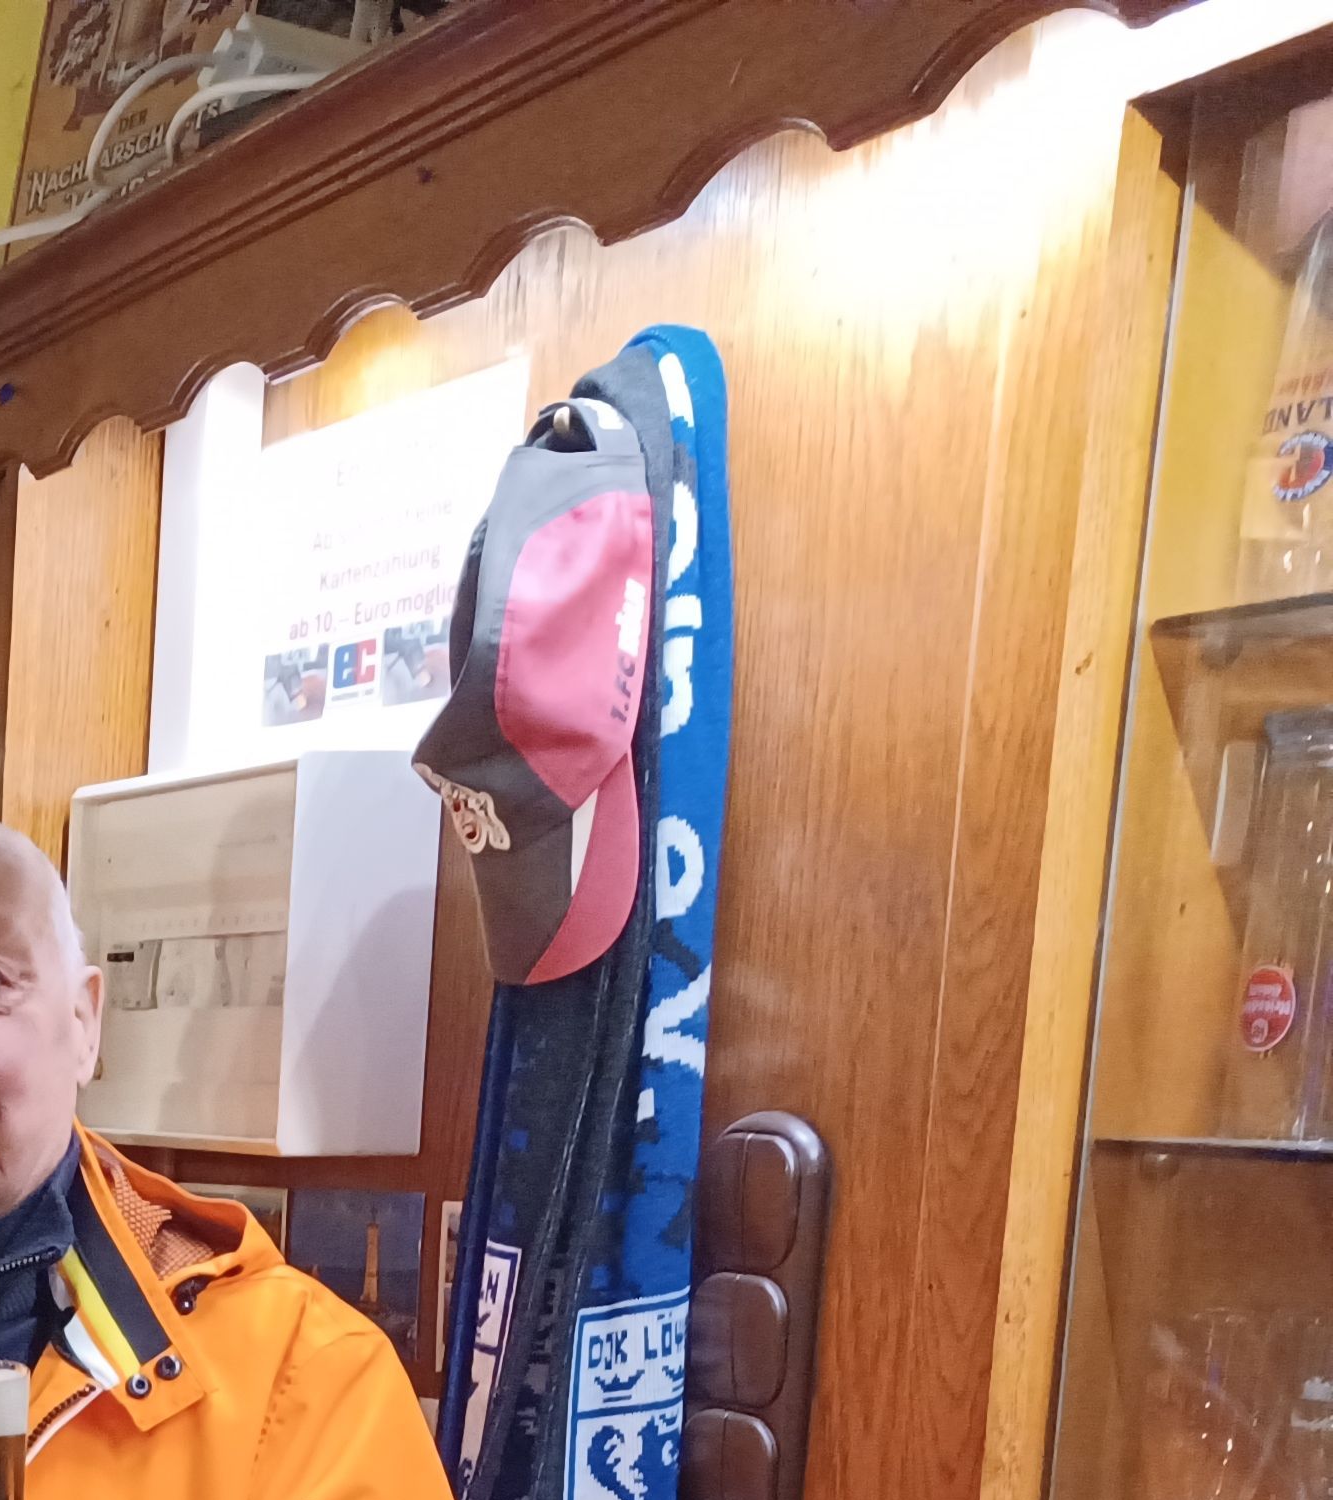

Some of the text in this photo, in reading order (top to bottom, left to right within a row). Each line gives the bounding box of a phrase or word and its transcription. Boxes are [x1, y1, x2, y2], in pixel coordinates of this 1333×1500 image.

[289, 614, 309, 641] ab
[353, 599, 391, 625] Euro
[587, 1329, 628, 1371] DJK
